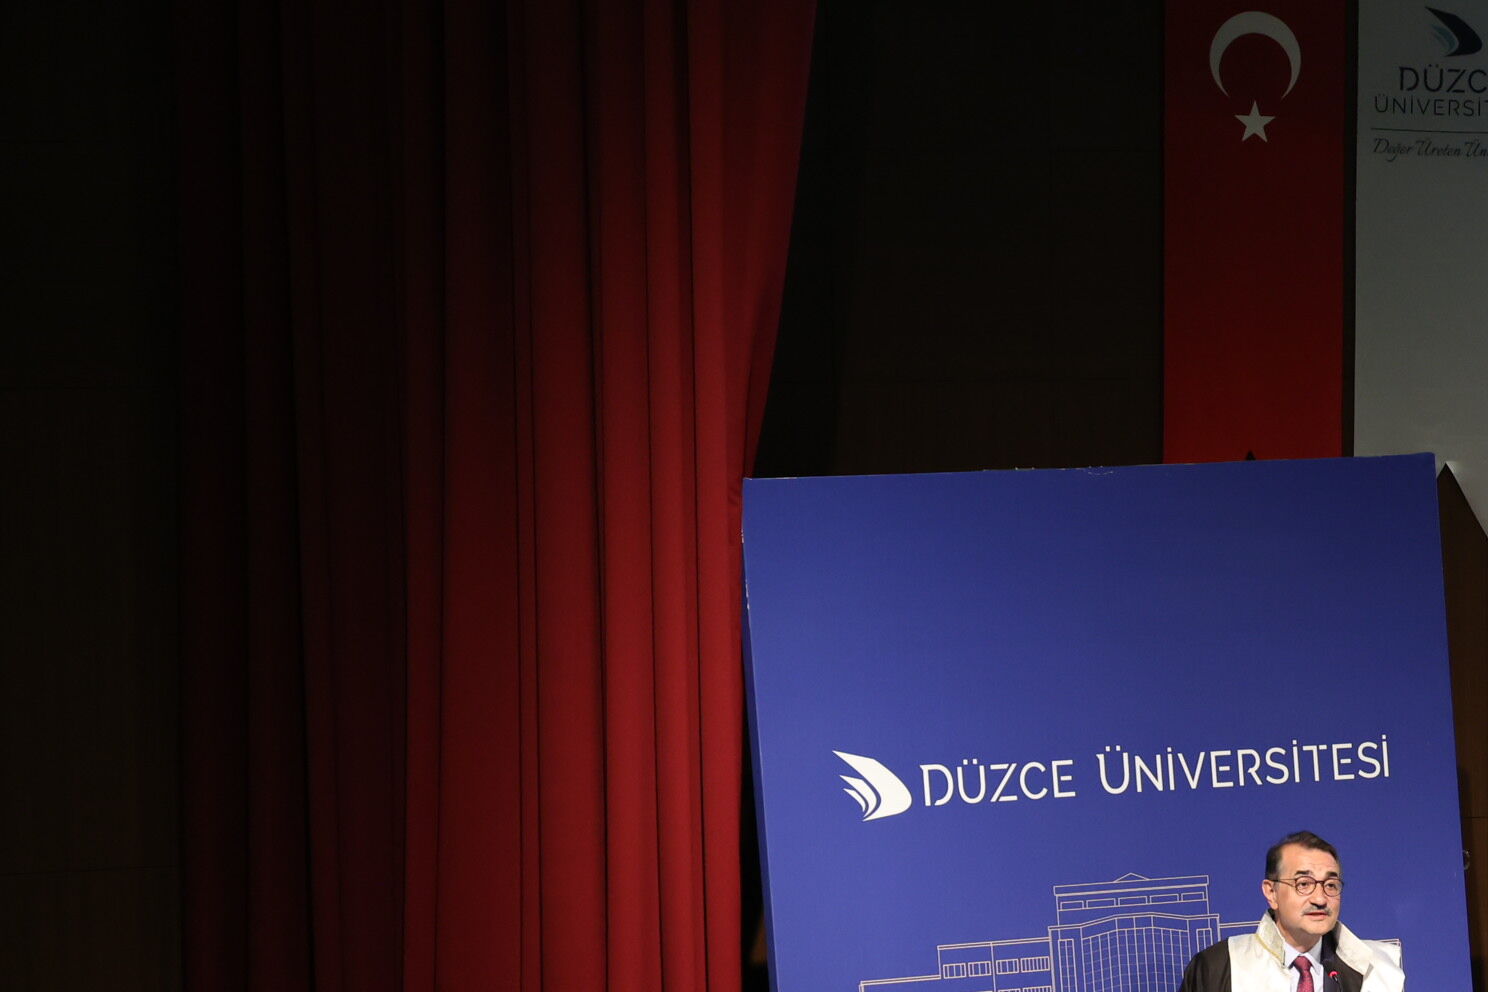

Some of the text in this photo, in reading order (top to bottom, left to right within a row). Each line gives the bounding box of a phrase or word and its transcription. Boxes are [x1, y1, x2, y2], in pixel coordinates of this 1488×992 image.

[1372, 137, 1412, 163] Değer
[1415, 138, 1461, 157] Üreten
[919, 734, 1391, 808] DÜZCE ÜNİVERSİTESİ
